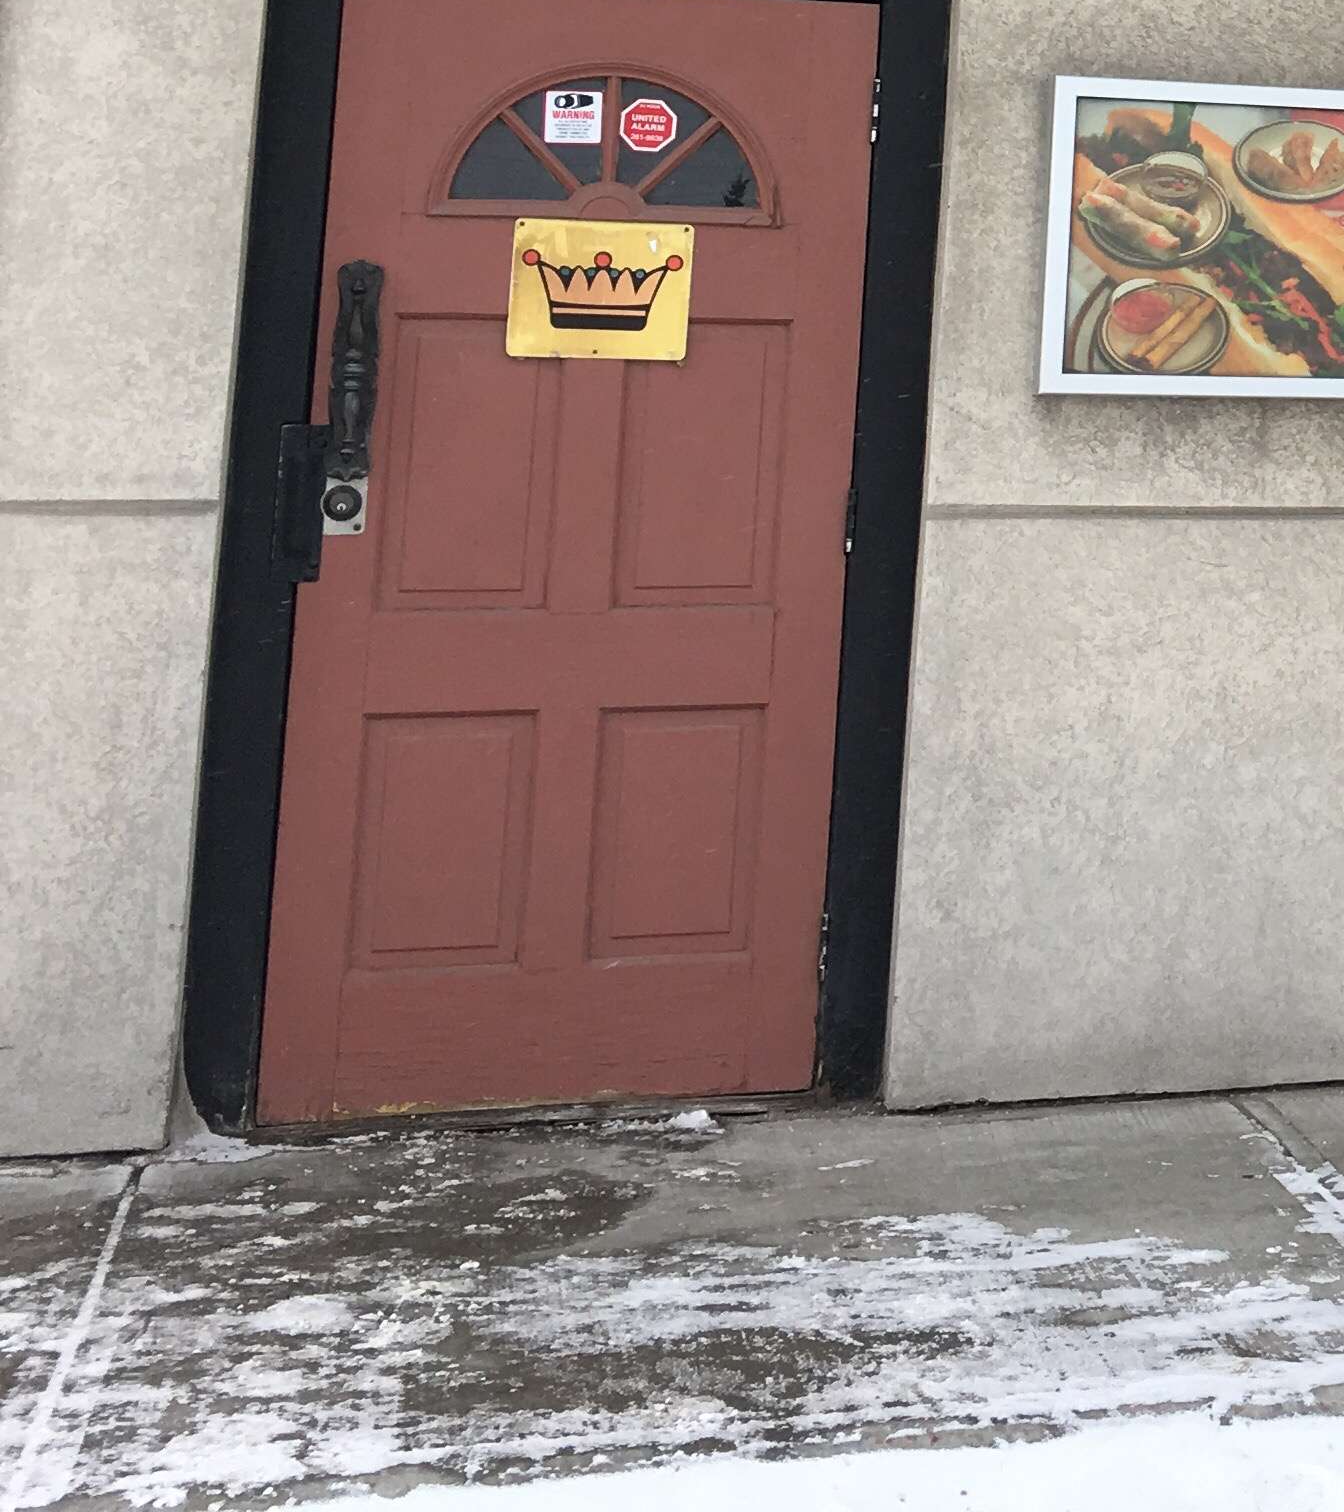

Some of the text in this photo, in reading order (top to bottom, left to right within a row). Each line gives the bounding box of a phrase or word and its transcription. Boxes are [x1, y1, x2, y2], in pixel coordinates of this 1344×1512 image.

[552, 110, 595, 119] WARNING
[631, 113, 667, 123] UNITED
[630, 122, 665, 131] ALARM
